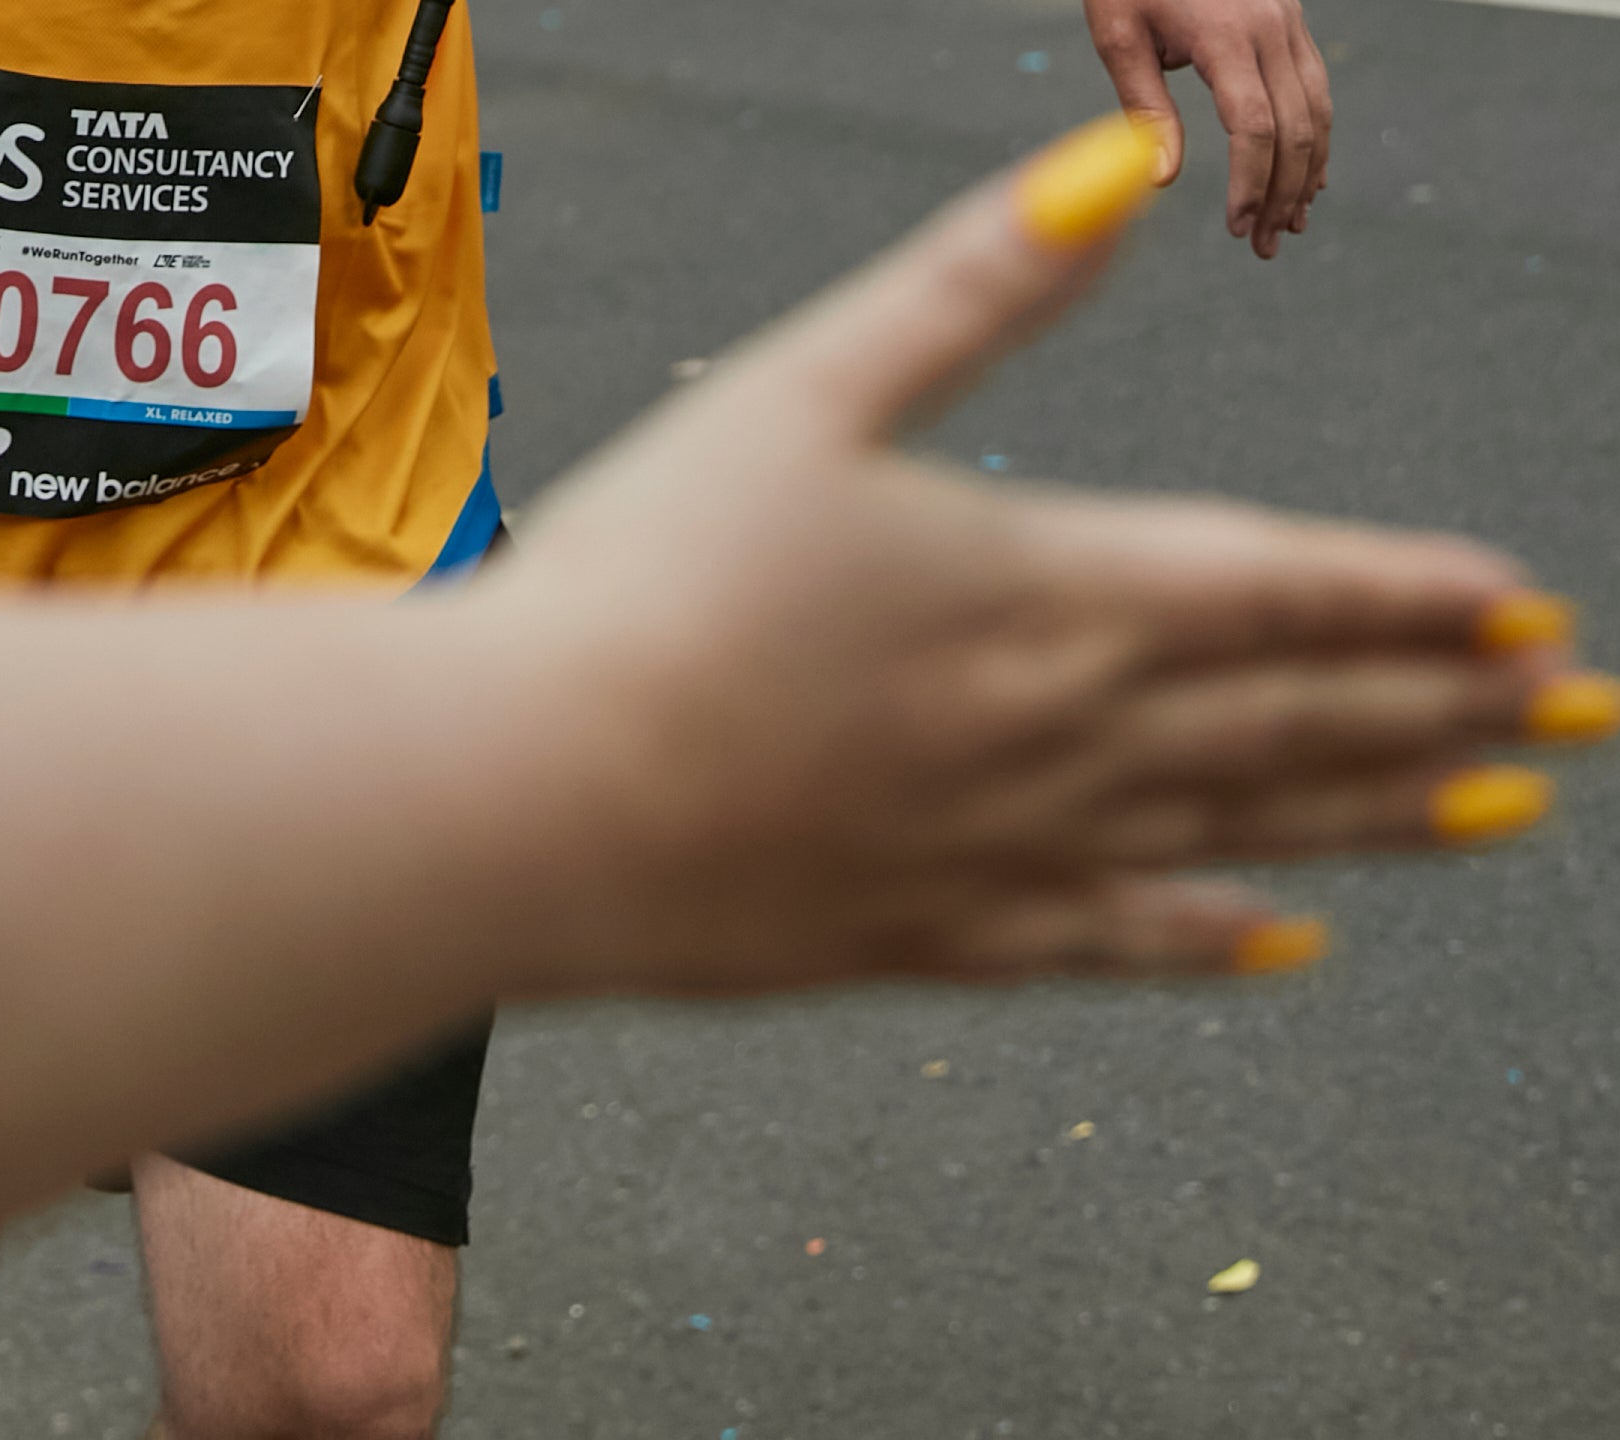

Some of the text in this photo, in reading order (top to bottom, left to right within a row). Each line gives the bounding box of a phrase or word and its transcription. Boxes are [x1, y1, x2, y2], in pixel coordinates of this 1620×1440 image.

[69, 108, 169, 140] TATA
[64, 143, 295, 180] CONSULTANCY
[62, 179, 209, 213] SERVICES
[21, 246, 140, 267] #WeRunTogether
[170, 408, 233, 425] RELAXED
[8, 462, 241, 503] new balance
